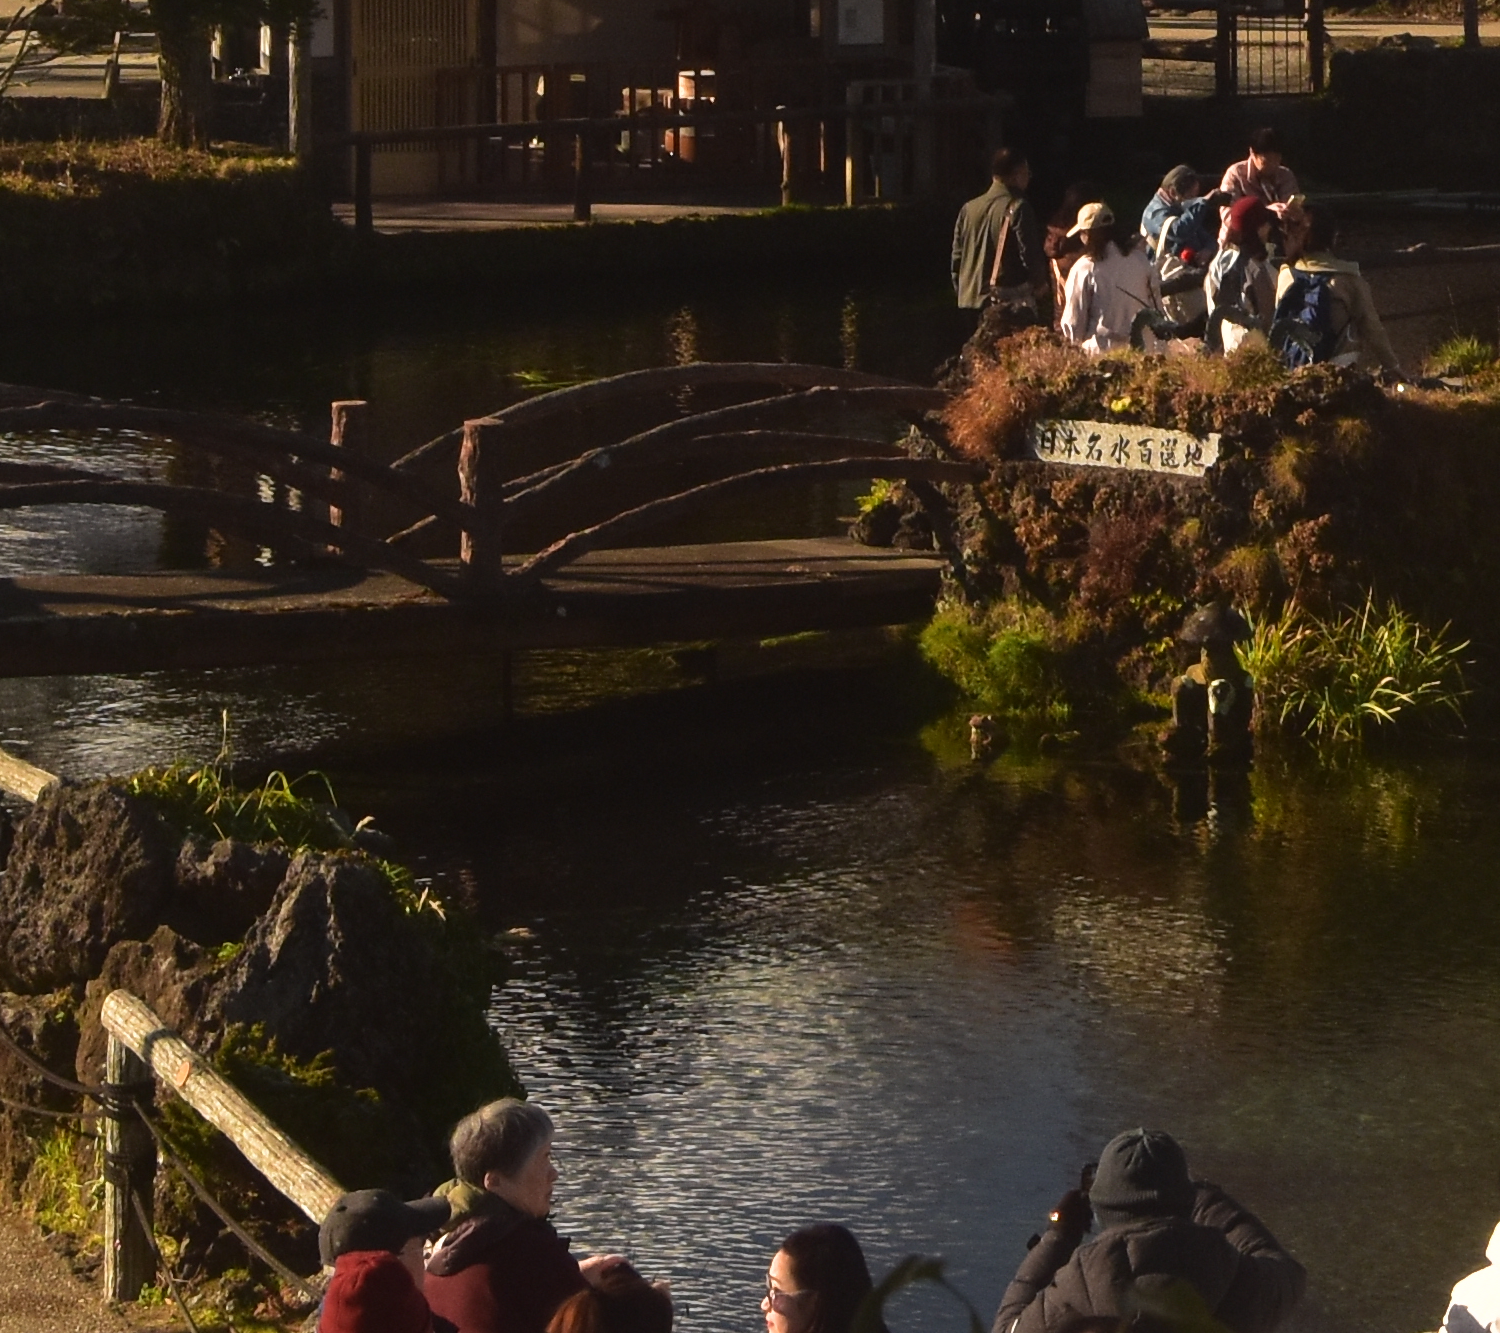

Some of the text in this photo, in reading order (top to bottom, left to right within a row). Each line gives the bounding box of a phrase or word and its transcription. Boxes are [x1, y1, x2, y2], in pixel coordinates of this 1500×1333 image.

[1040, 428, 1205, 469] 日本名水百選地
